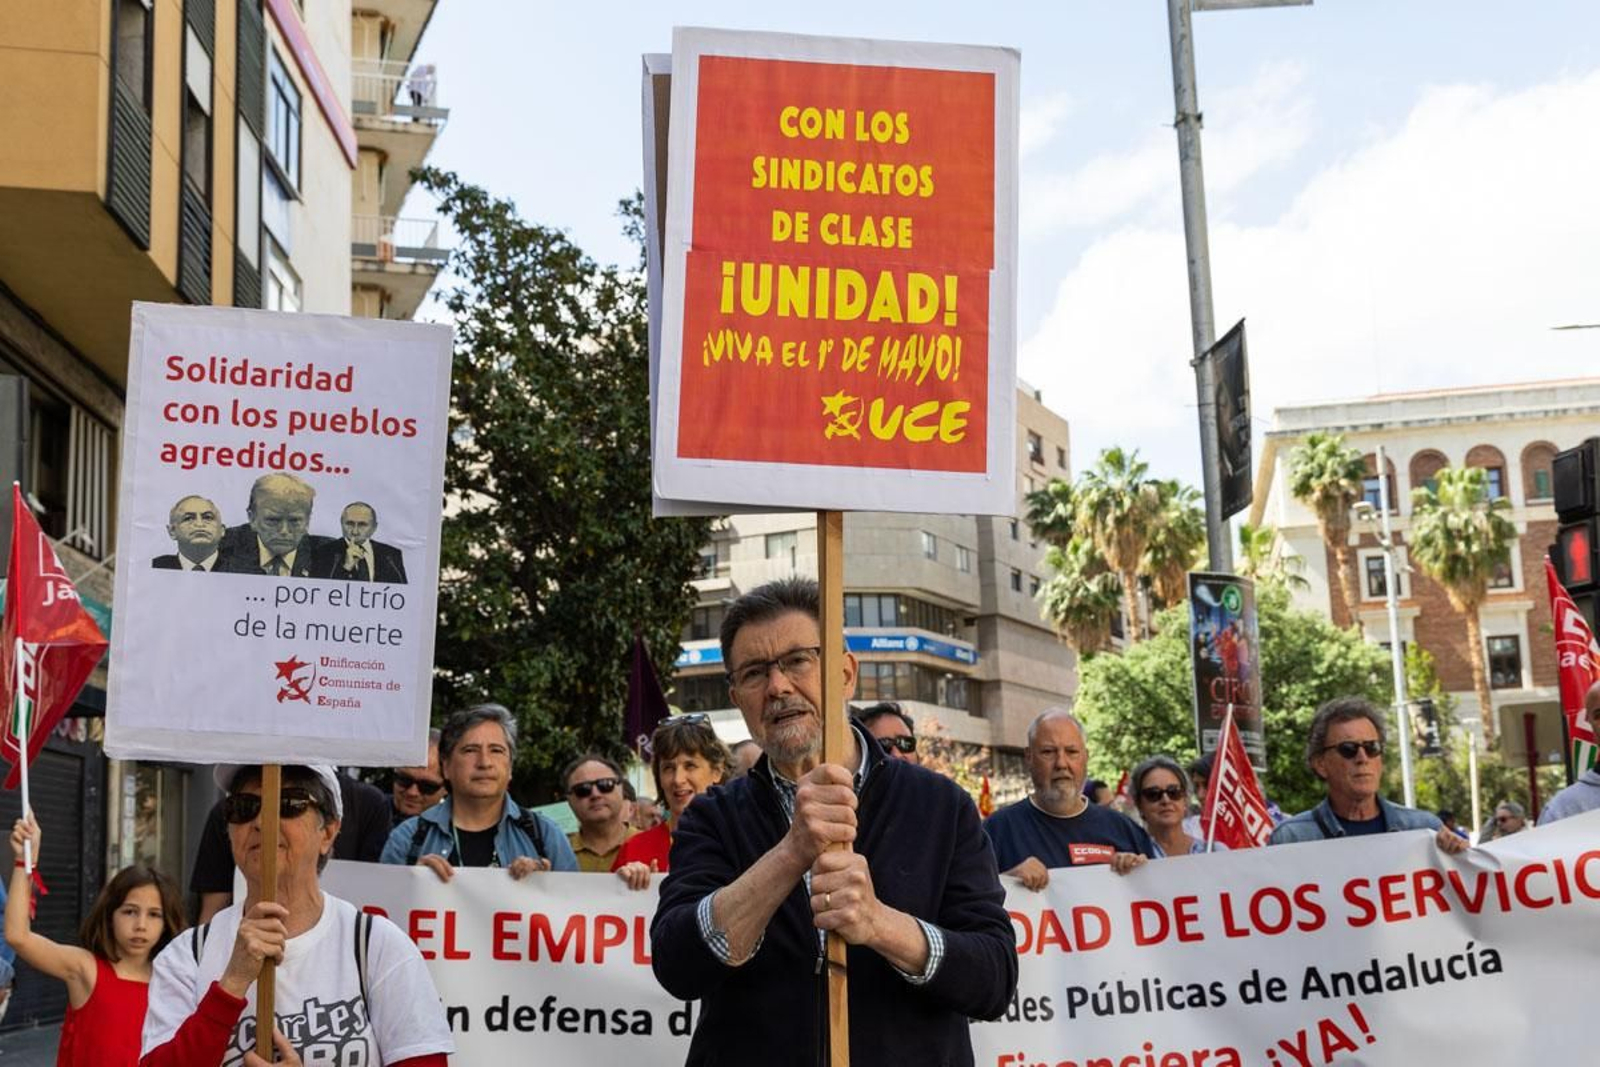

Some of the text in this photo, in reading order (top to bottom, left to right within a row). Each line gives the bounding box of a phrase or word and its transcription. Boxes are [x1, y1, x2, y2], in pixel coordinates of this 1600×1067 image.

[780, 105, 910, 144] CON LOS
[752, 156, 934, 197] SINDICATOS
[772, 211, 912, 248] DE CLASE
[720, 261, 958, 327] ¡UNIDAD!
[165, 355, 354, 393] Solidaridad
[703, 329, 773, 367] ¡VIVA
[781, 341, 810, 368] EL
[841, 336, 875, 373] DE
[878, 333, 962, 386] MAYO!
[163, 399, 418, 437] con los pueblos
[868, 397, 971, 443] UCE
[160, 440, 350, 474] agredidos...
[275, 584, 321, 607] por
[328, 584, 351, 607] el
[360, 586, 405, 610] trío
[234, 614, 402, 646] de la muerte
[320, 656, 385, 670] Unificación
[317, 695, 361, 709] España
[319, 676, 401, 691] Comunista de
[1130, 895, 1205, 946] DE
[1220, 883, 1327, 938] LOS
[1066, 977, 1226, 1019] Públicas
[1238, 968, 1287, 1004] de
[1301, 941, 1502, 1000] Andalucía
[484, 995, 652, 1035] defensa
